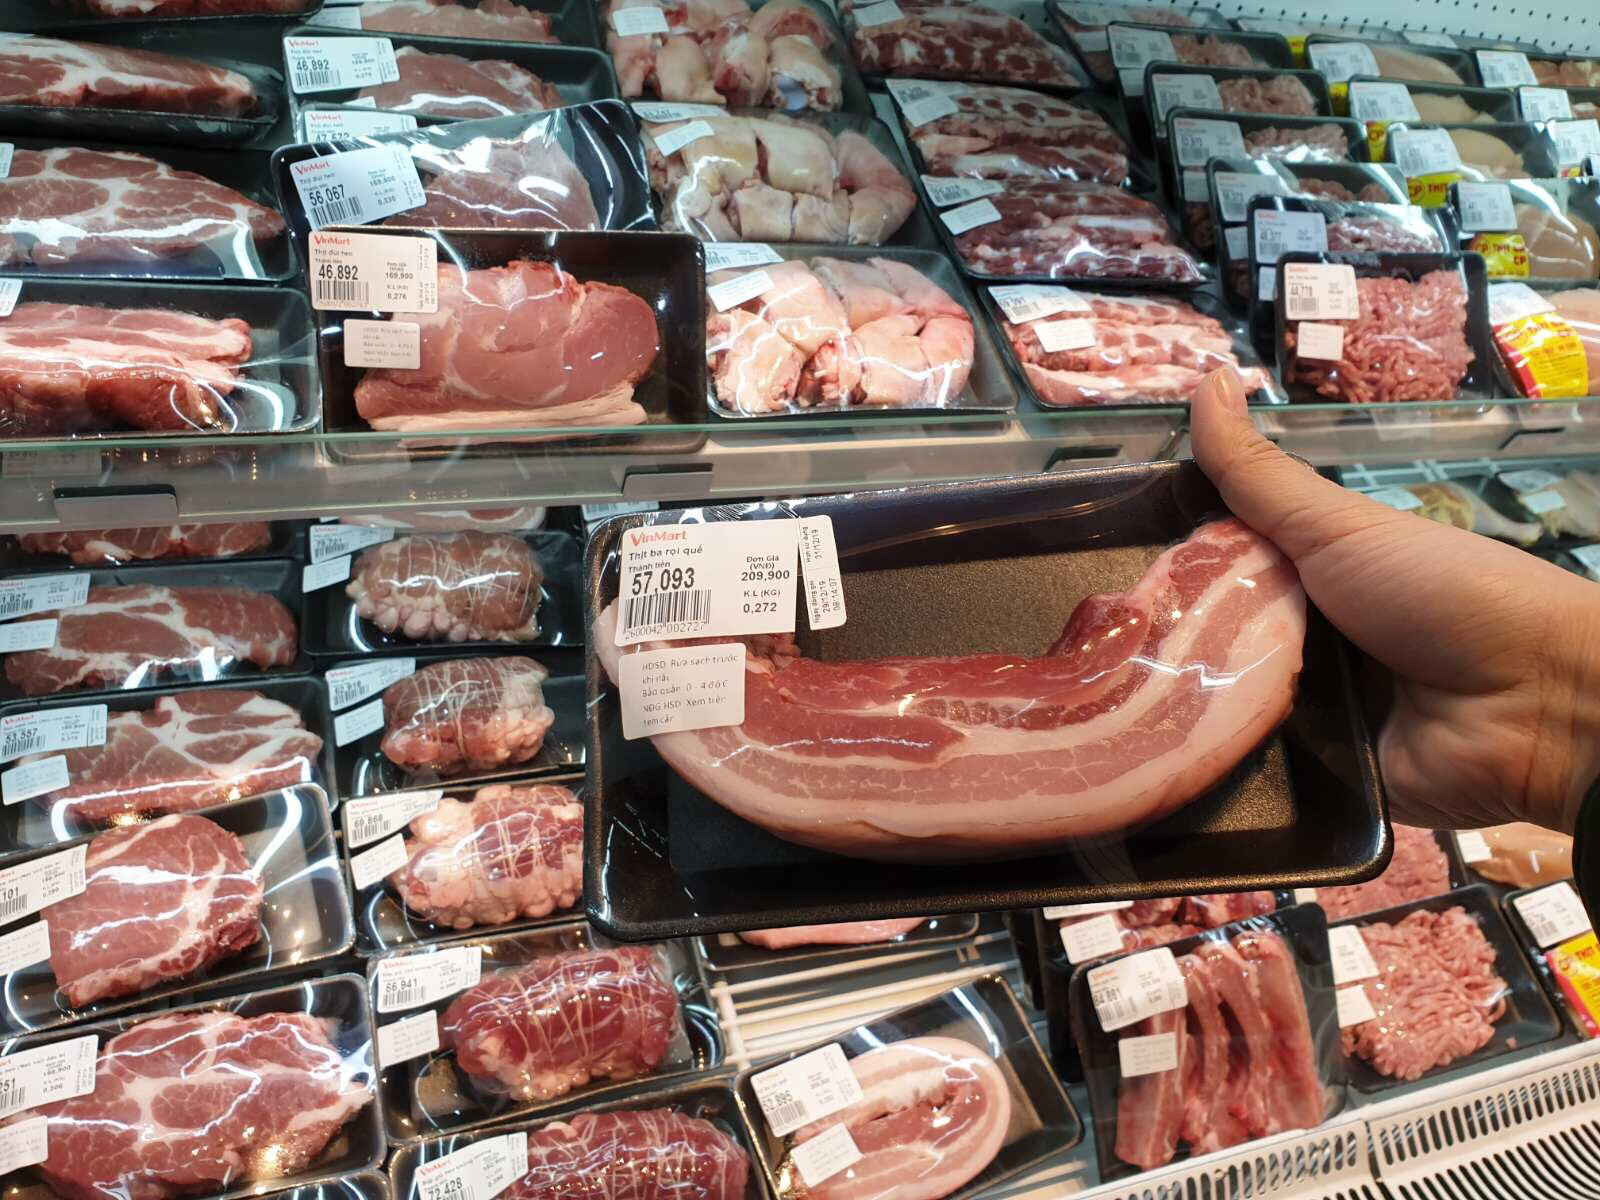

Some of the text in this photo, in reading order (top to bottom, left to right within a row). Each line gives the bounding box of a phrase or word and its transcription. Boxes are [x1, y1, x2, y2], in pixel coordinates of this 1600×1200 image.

[314, 234, 351, 246] VinMart
[318, 263, 359, 281] 46,892
[629, 529, 688, 547] VinMart
[631, 567, 695, 596] 57,093
[741, 569, 790, 582] 209,900
[818, 580, 831, 613] 29/12/19
[743, 602, 777, 614] 0,272
